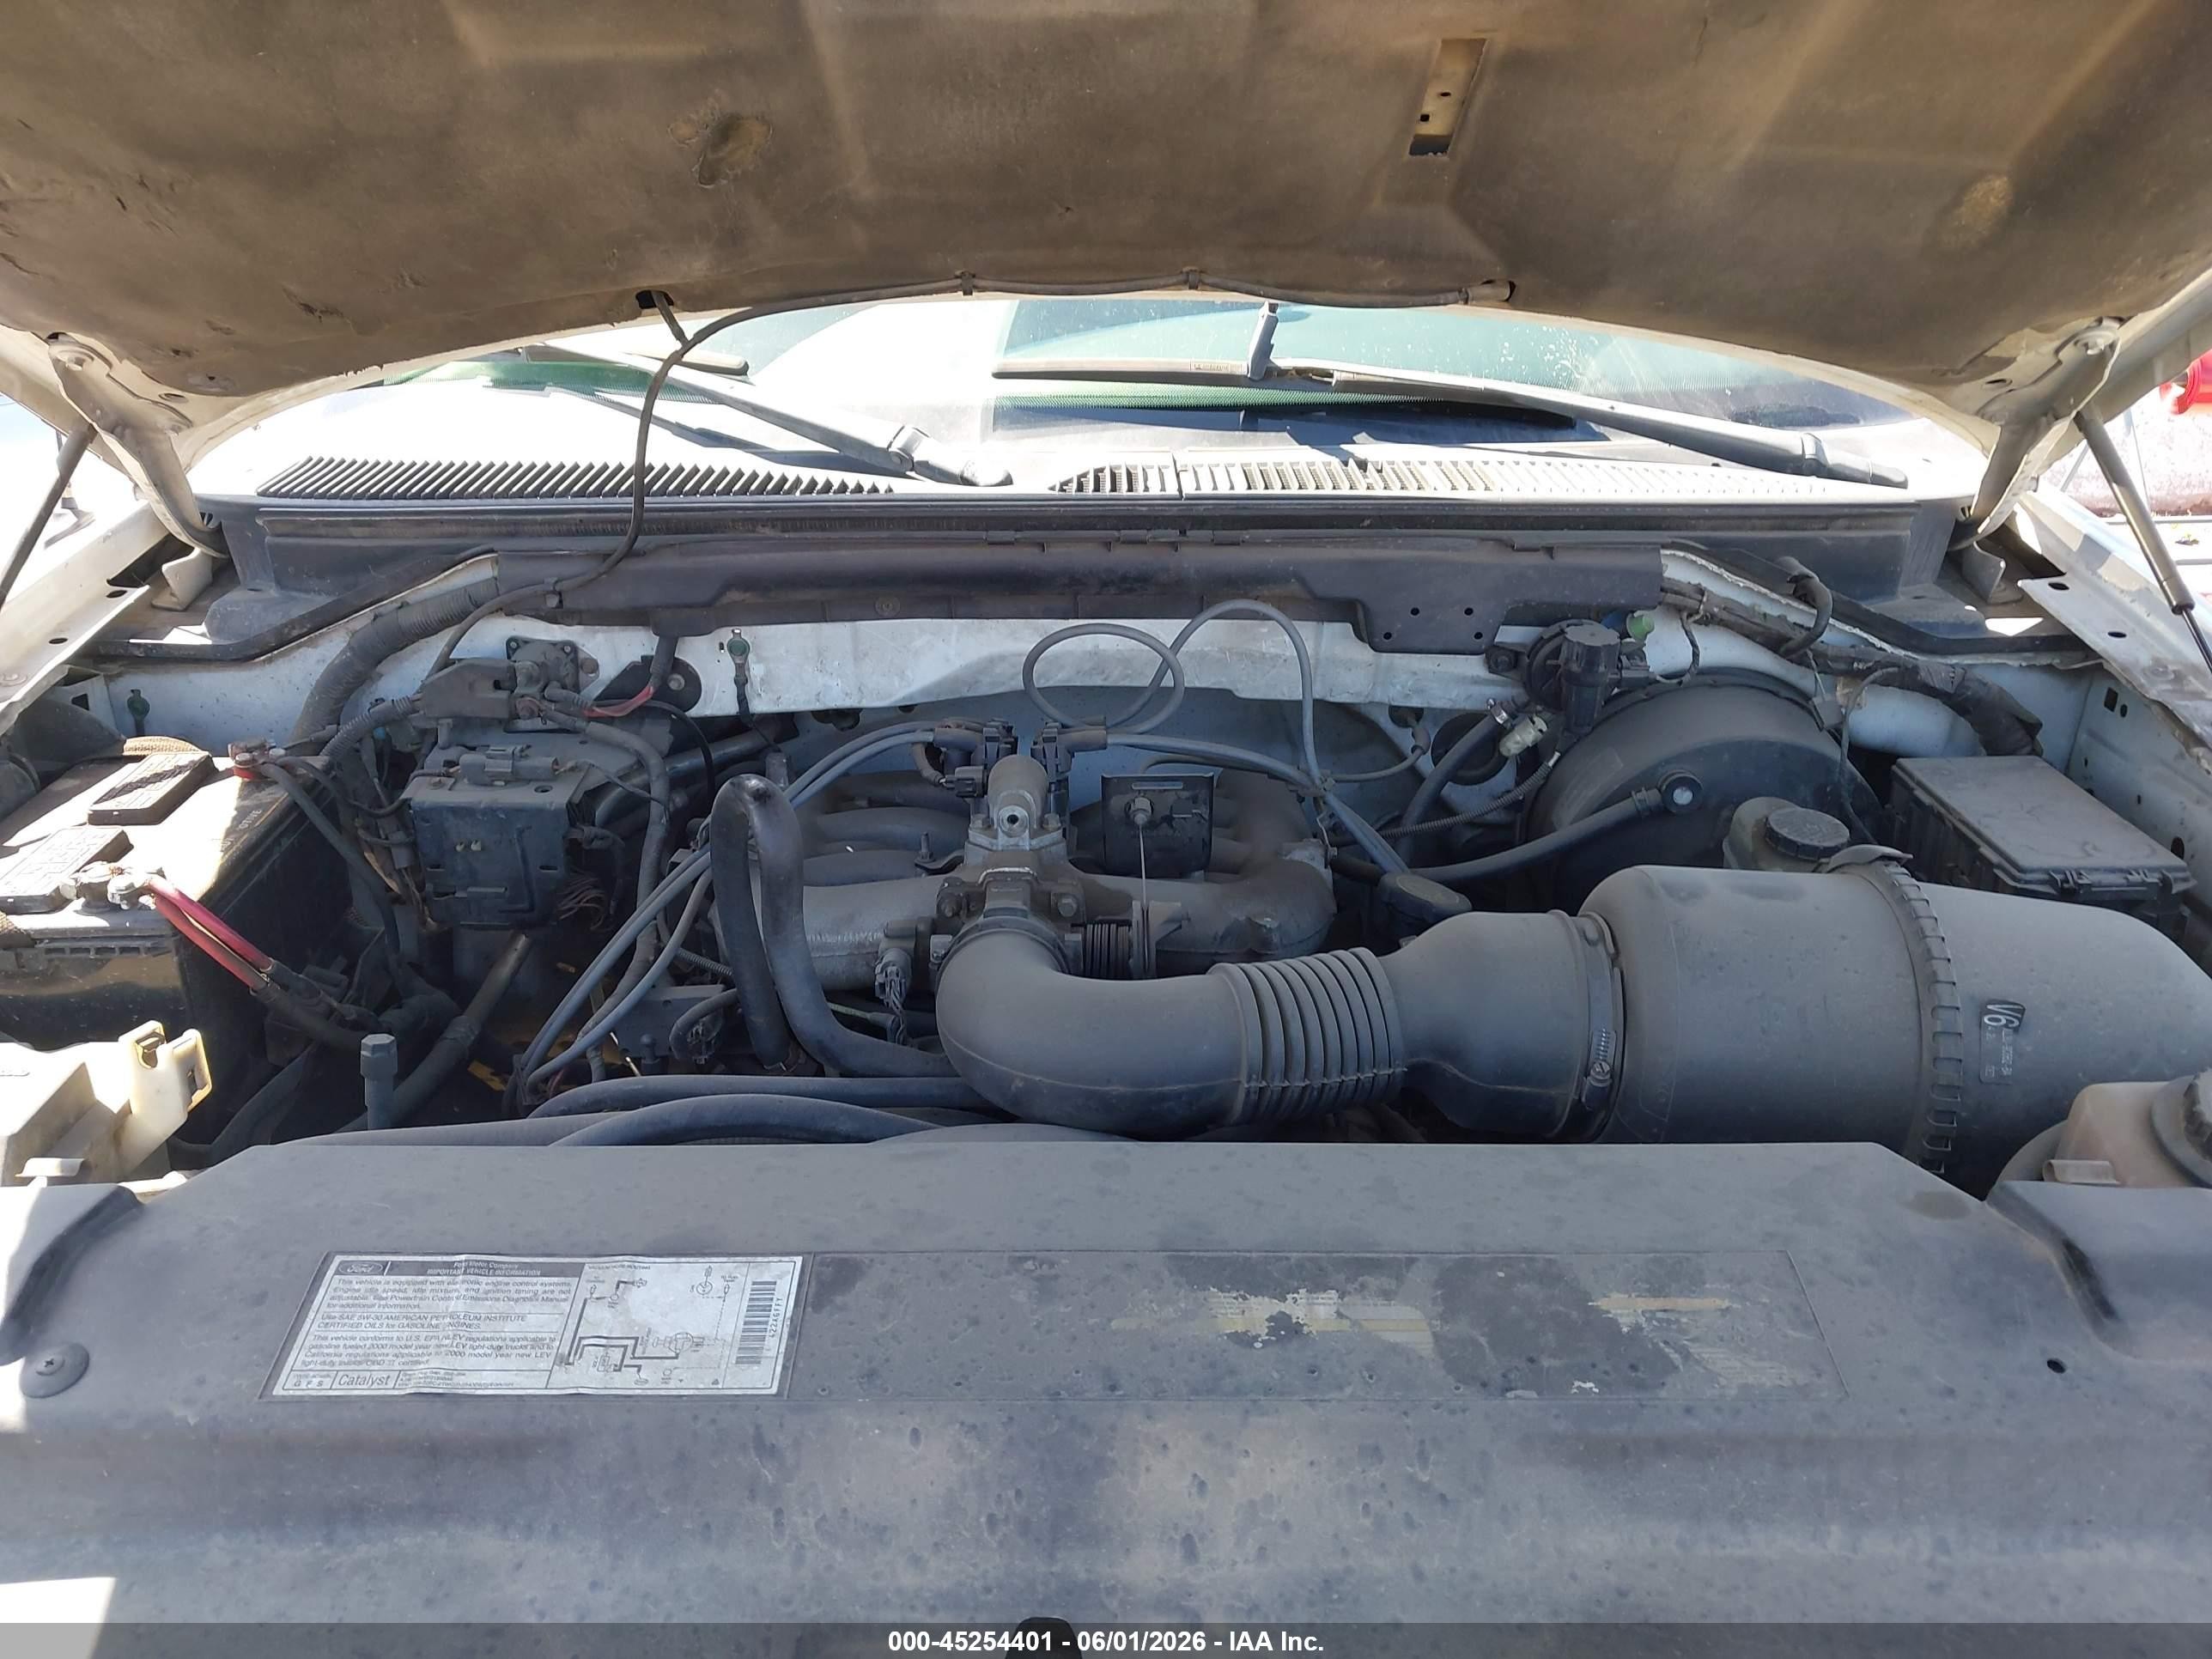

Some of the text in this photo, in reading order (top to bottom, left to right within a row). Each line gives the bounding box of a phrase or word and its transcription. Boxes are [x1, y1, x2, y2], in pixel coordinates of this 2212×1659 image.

[1984, 1004, 2022, 1027] V6
[346, 1262, 374, 1273] Ford
[466, 1268, 493, 1277] VEHICLE
[333, 1286, 362, 1295] Engine
[514, 1288, 539, 1297] timing
[445, 1349, 466, 1358] 2000
[337, 1374, 392, 1389] Catalyst
